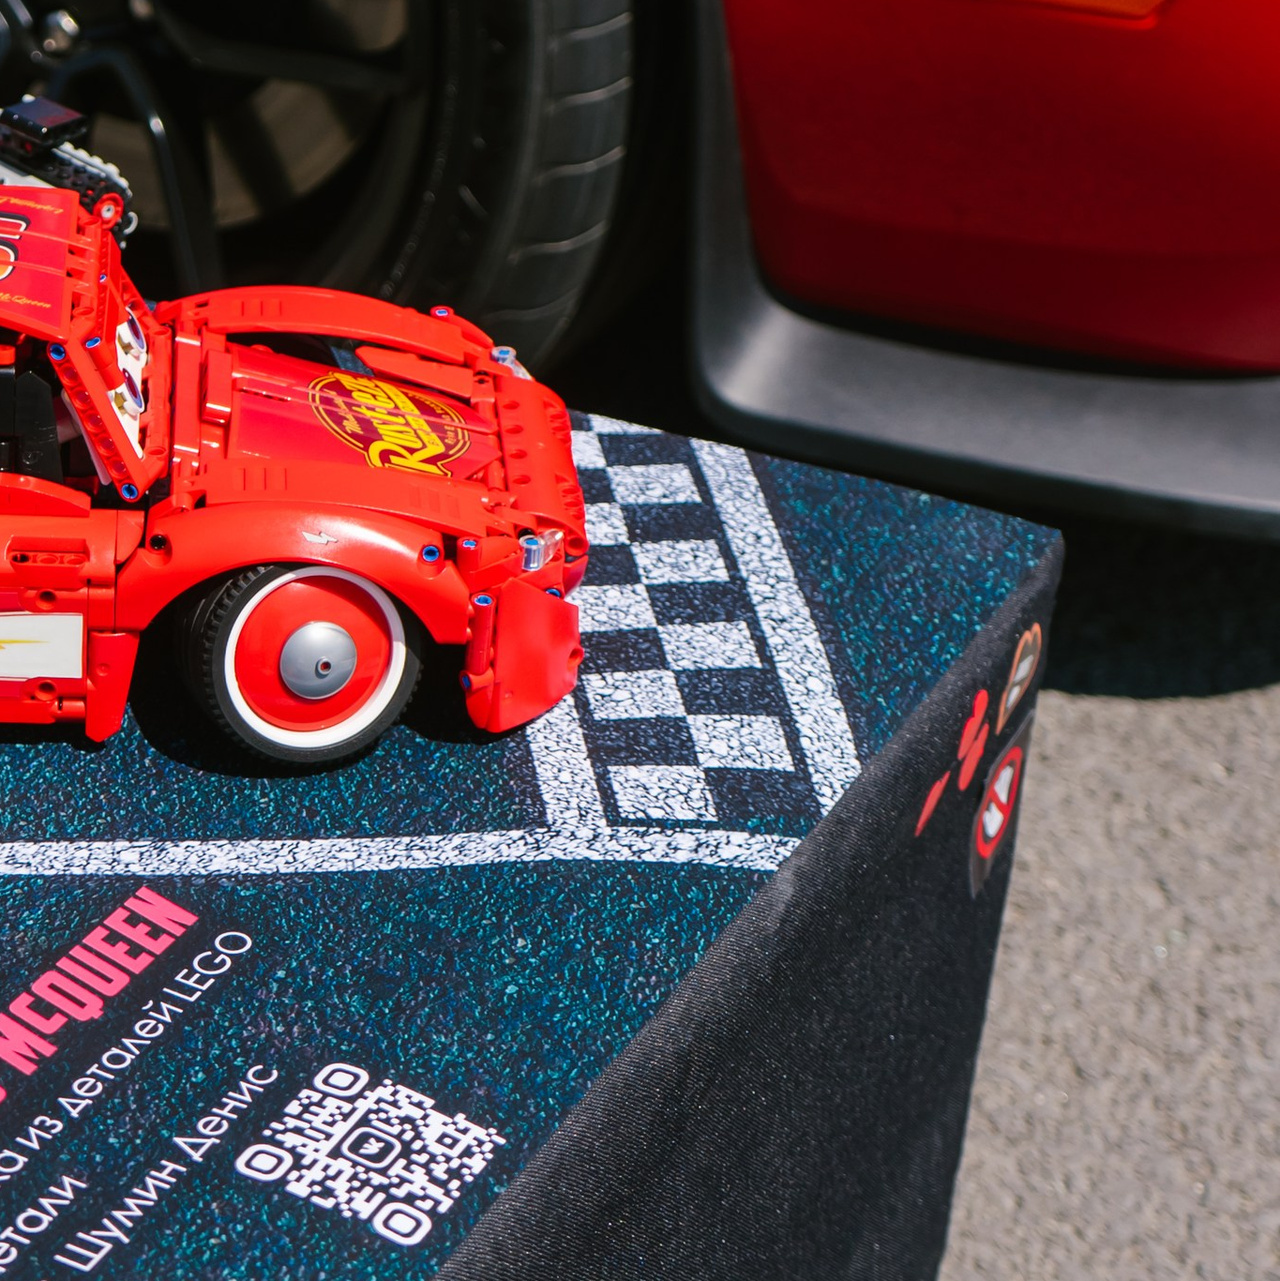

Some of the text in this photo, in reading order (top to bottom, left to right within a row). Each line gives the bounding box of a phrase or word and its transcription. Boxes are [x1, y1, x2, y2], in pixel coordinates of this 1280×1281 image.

[14, 1114, 65, 1151] из
[57, 1000, 186, 1119] деталей
[161, 930, 254, 1004] LEGO
[53, 1158, 188, 1274] Шумин
[171, 1063, 280, 1163] Денис
